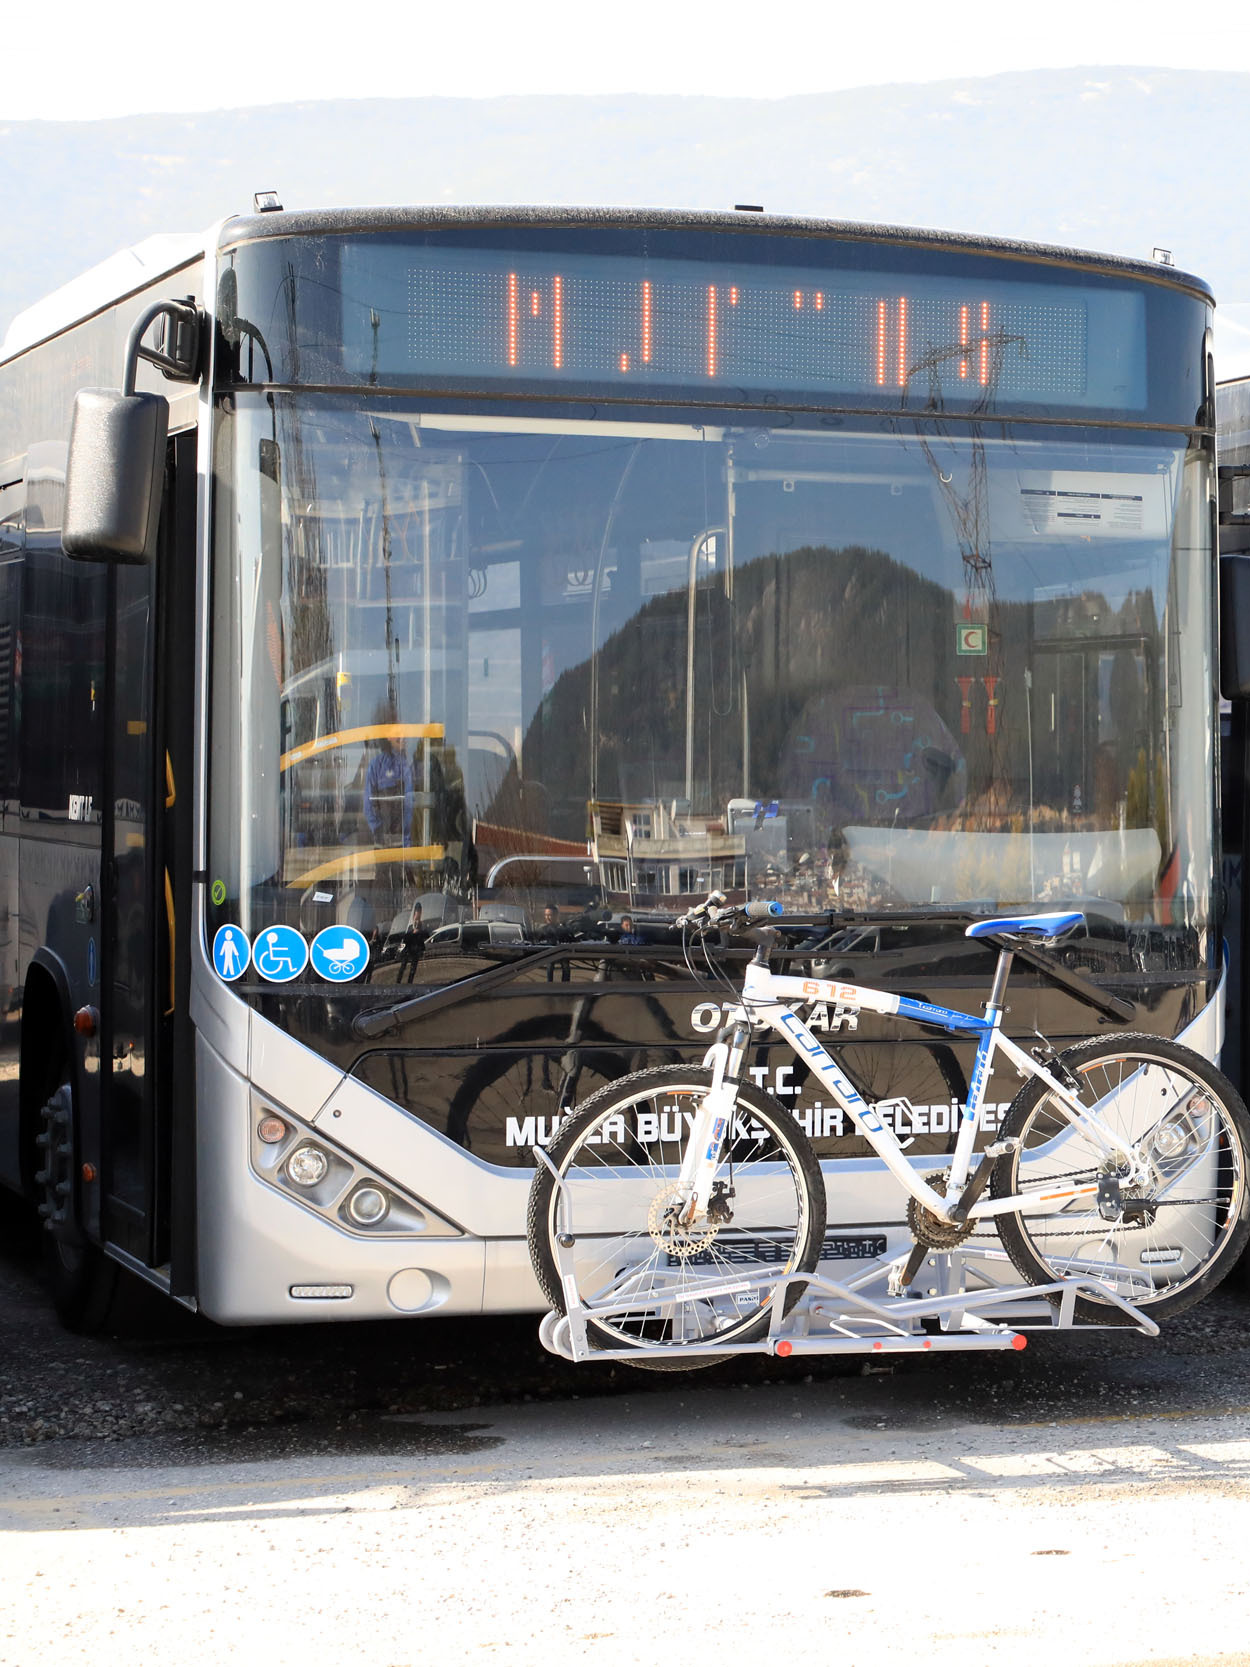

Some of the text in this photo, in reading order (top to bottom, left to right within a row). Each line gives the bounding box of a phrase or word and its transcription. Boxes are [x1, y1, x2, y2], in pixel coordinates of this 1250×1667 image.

[691, 1002, 860, 1033] OTAR
[750, 1066, 802, 1095] T.C.
[781, 1013, 884, 1133] carraro
